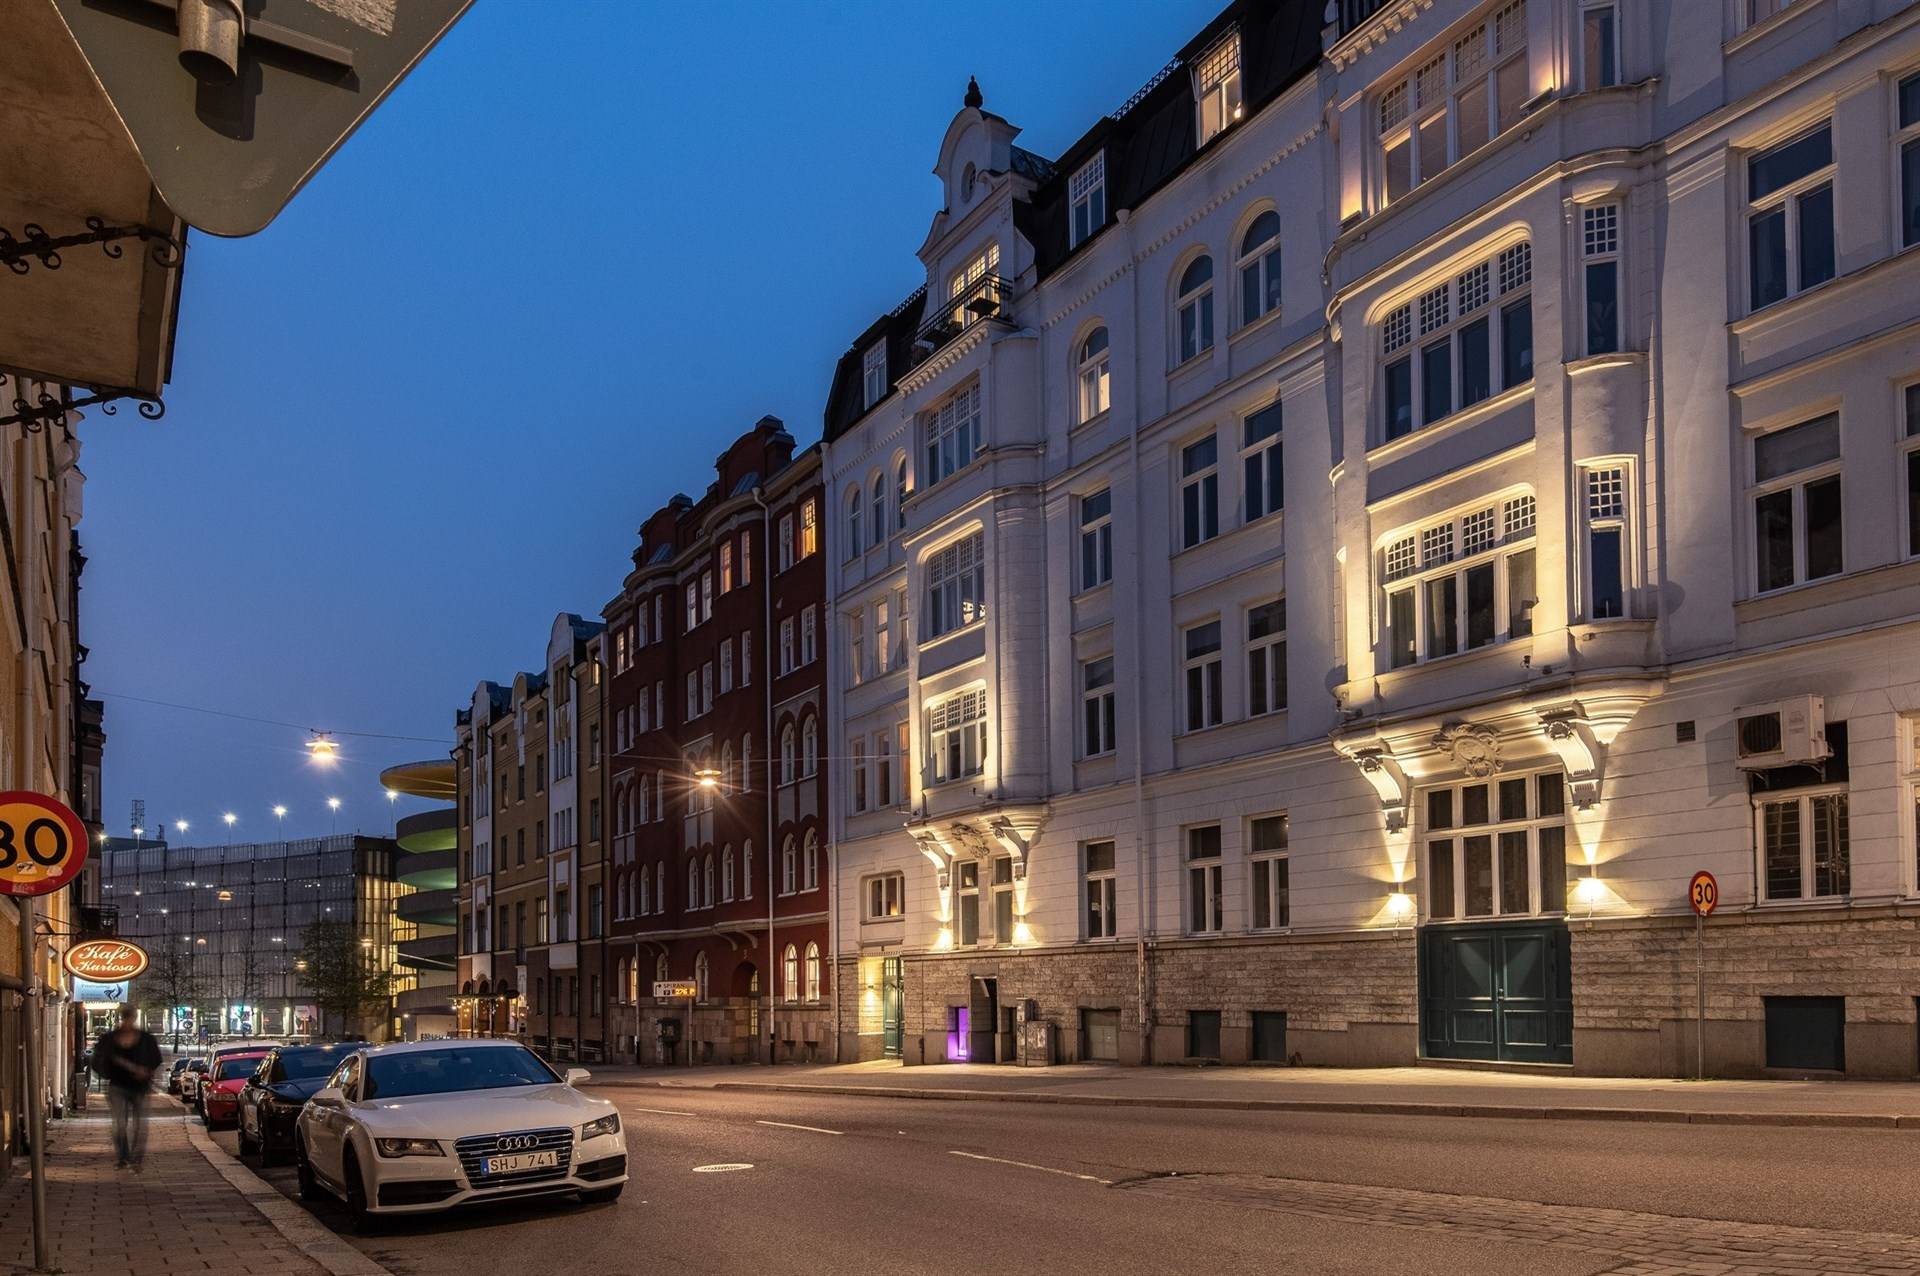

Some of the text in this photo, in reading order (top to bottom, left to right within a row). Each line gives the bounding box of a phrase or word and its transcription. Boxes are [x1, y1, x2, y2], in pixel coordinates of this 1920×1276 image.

[1695, 883, 1714, 904] 30
[79, 945, 133, 965] Kafé
[75, 960, 137, 972] Kuriosa
[490, 1153, 553, 1171] SHJ 741
